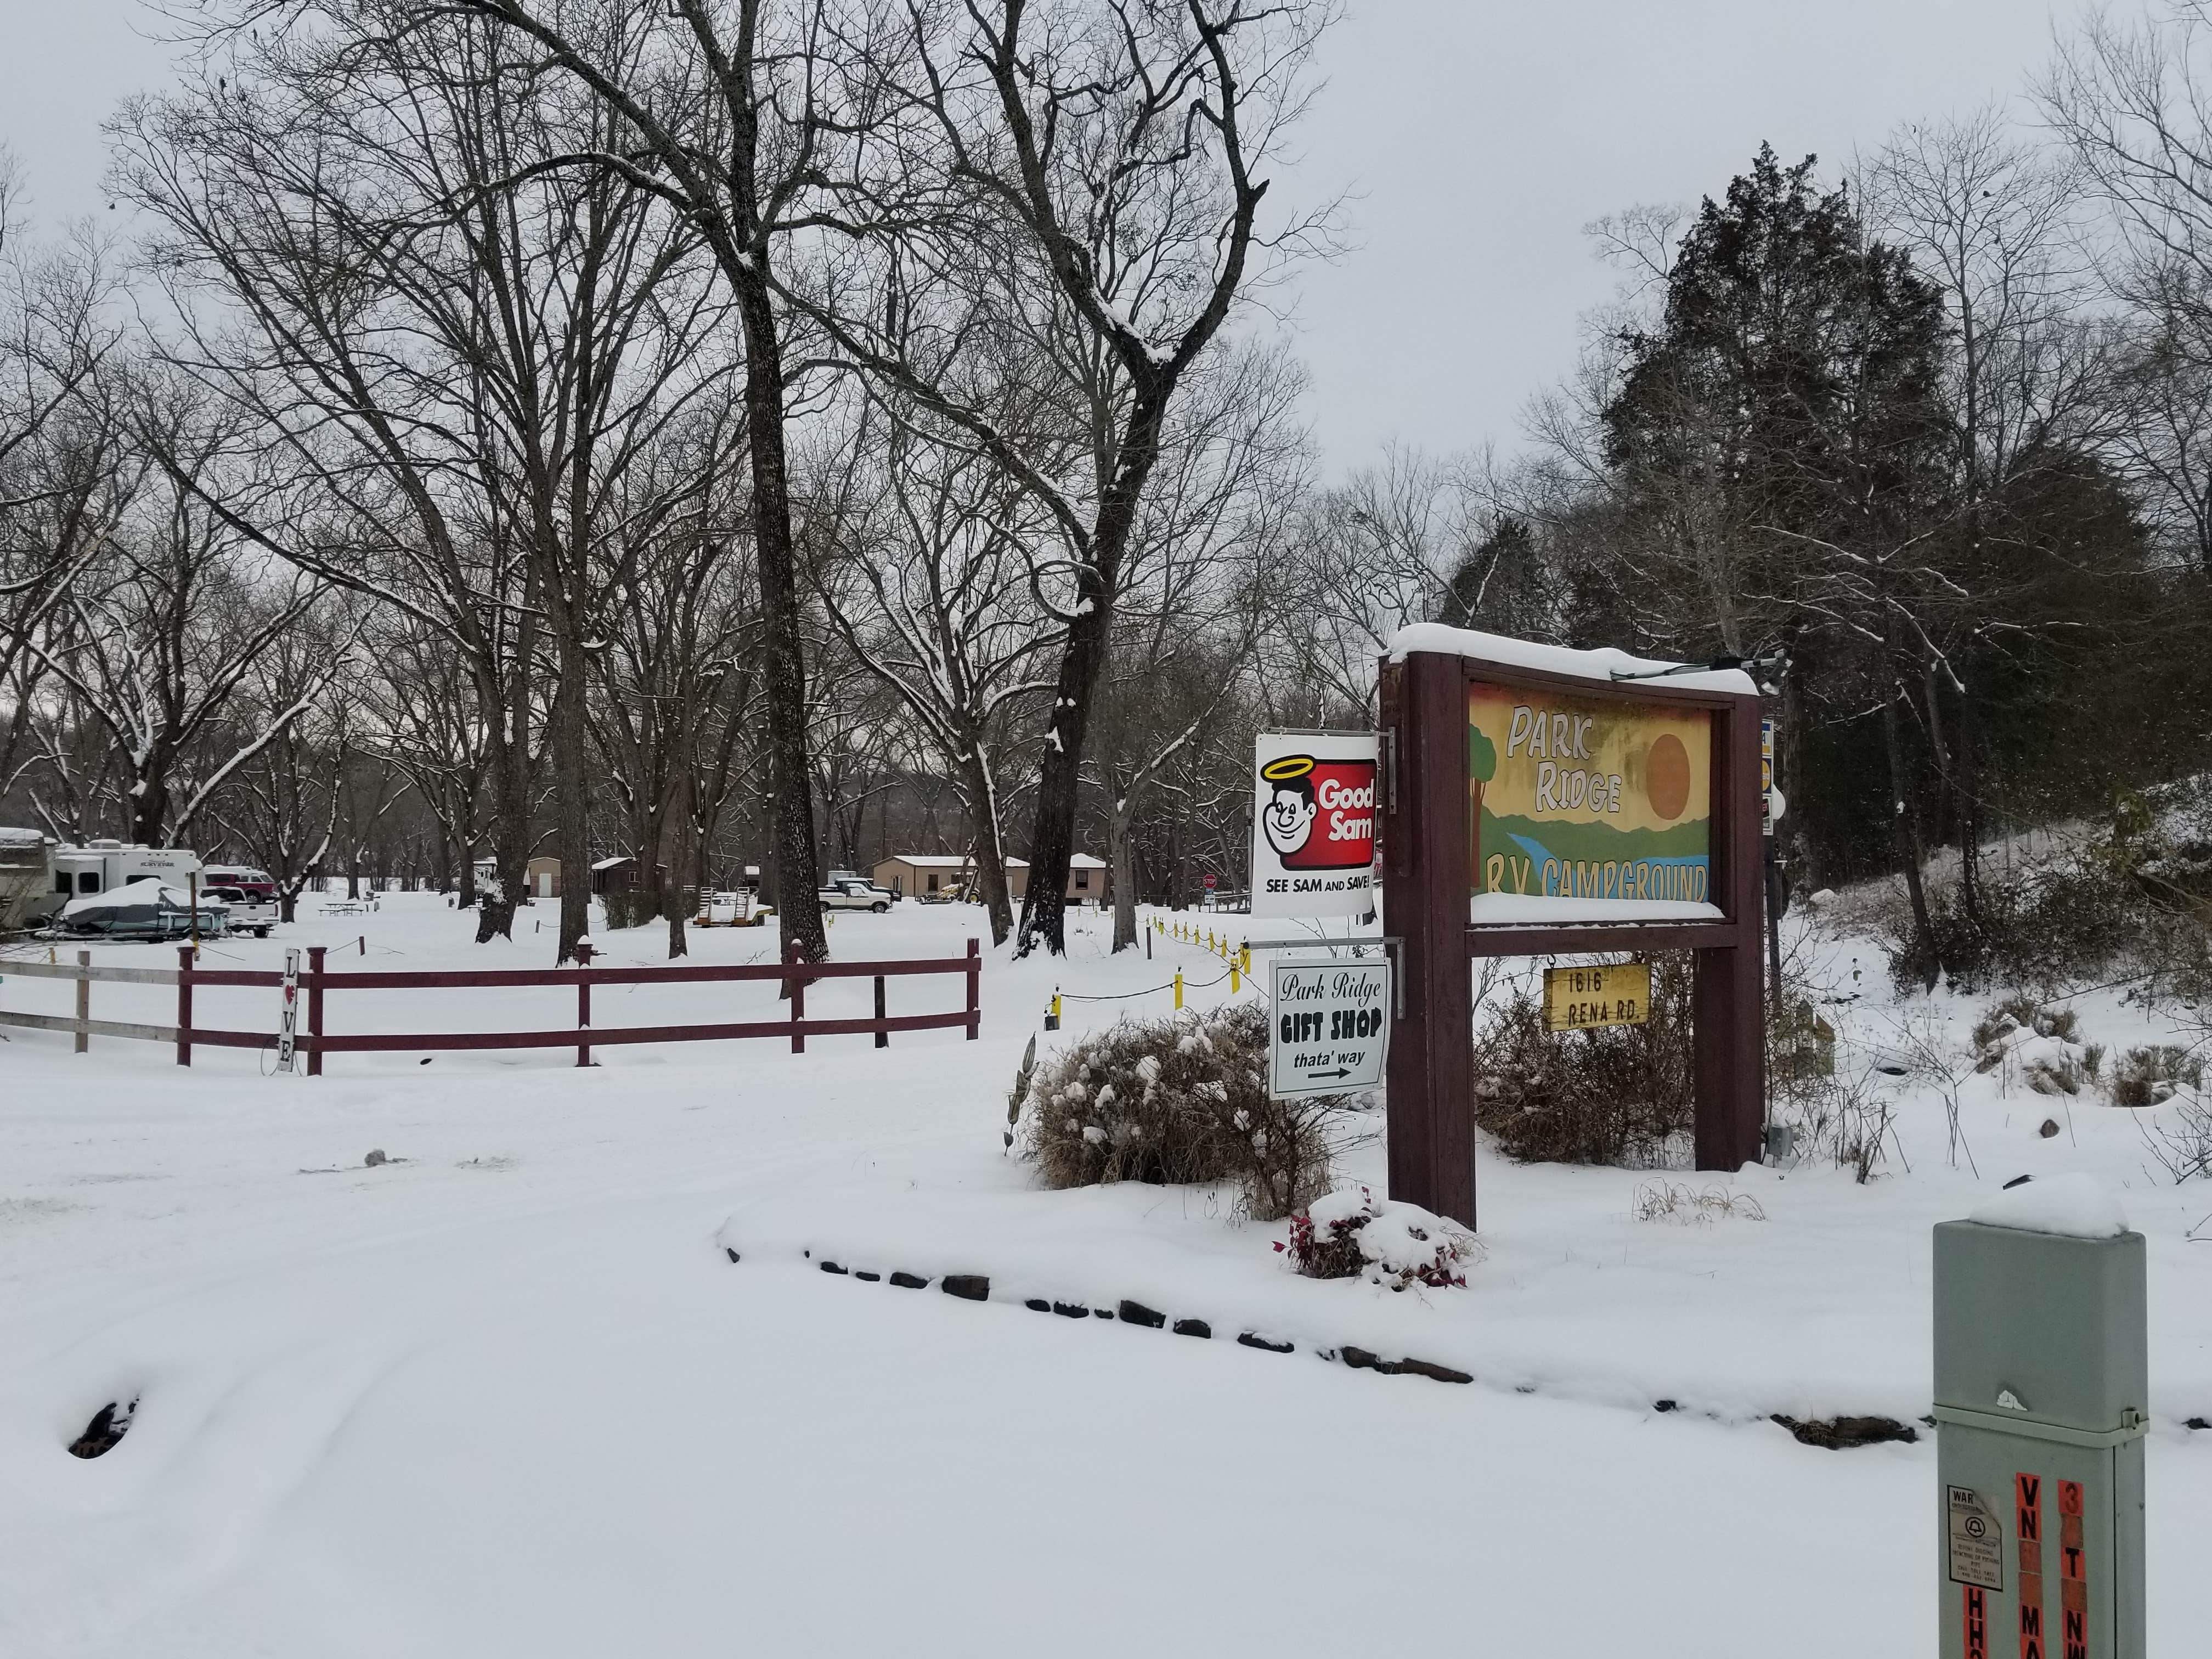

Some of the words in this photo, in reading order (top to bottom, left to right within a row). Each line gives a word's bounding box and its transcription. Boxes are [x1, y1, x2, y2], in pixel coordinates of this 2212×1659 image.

[1506, 706, 1593, 760] PARK
[1319, 778, 1374, 809] Good
[1535, 761, 1622, 812] RIDGE
[1328, 811, 1372, 841] Sam
[1266, 879, 1288, 893] SEE
[1293, 879, 1322, 893] SAM
[1347, 875, 1369, 890] SAVE!
[1486, 853, 1530, 894] RV
[1541, 859, 1707, 903] CAMPGROUND
[1280, 974, 1324, 1001] Park
[1332, 972, 1380, 1007] Ridge
[1570, 972, 1602, 992] 1616
[1281, 1012, 1323, 1043] GIFT
[1330, 1007, 1382, 1040] SHOP
[1568, 1001, 1607, 1027] RENA
[1617, 1000, 1639, 1020] RD.
[1294, 1050, 1334, 1068] thata'
[1338, 1052, 1365, 1066] way
